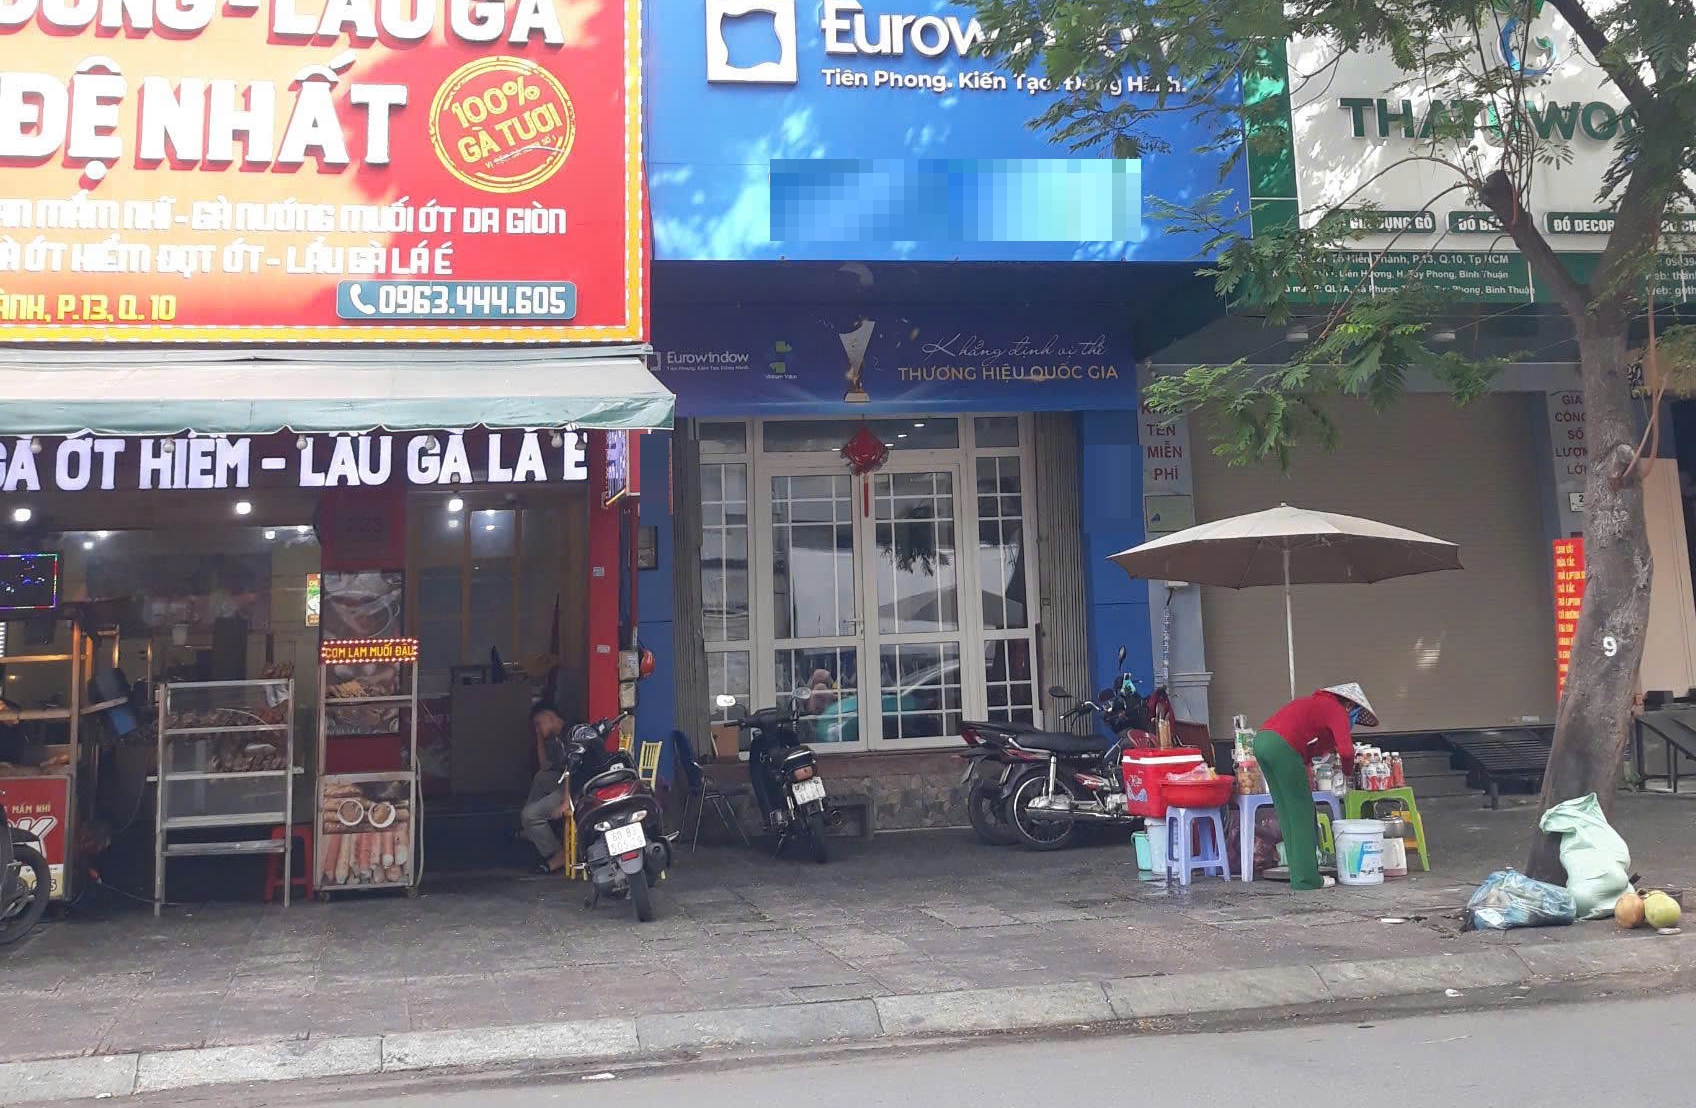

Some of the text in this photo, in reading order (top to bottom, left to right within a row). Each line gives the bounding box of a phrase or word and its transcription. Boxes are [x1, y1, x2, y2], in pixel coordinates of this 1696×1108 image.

[821, 69, 869, 87] Tiên
[874, 70, 953, 92] Phong.
[958, 69, 1007, 90] Kiến
[451, 75, 541, 128] 100%
[0, 50, 408, 180] ĐỆ NHẤT
[457, 126, 502, 163] GÀ
[340, 195, 414, 233] MUỐI
[418, 198, 457, 233] ỚT
[462, 206, 500, 234] DA
[506, 200, 567, 234] GIÒN
[24, 235, 68, 272] ỚT
[222, 237, 265, 274] ỚT
[391, 239, 430, 275] LÁ
[434, 241, 454, 275] É
[57, 294, 114, 323] P.13,
[118, 294, 145, 321] Q.
[150, 294, 177, 321] 10
[379, 285, 566, 315] 0963.444.605
[667, 350, 749, 364] Eurowindow
[898, 361, 1120, 383] THƯƠNG HIỆU QUỐC GIA
[1561, 394, 1583, 405] GIA
[1567, 426, 1584, 440] SỐ
[1147, 440, 1183, 459] MIỄN
[1154, 464, 1178, 481] PHÍ
[348, 646, 367, 658] LAM
[369, 642, 392, 657] MUỐI
[1603, 636, 1617, 657] 9
